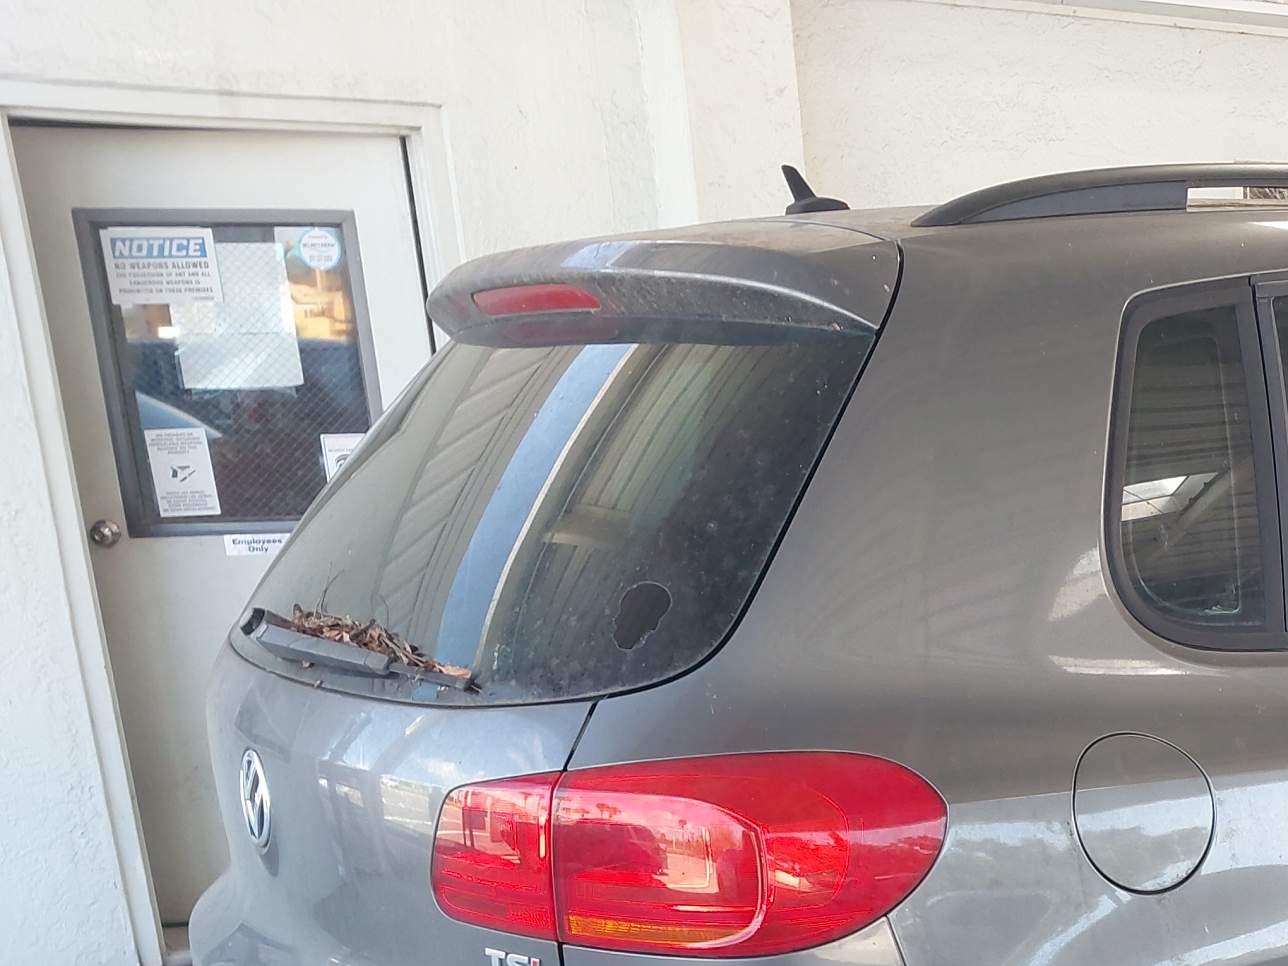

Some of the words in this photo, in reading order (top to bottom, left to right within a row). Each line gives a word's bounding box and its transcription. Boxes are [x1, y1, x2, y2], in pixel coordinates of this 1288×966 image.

[114, 238, 204, 257] NOTICE
[114, 262, 127, 270] NO
[129, 261, 169, 270] WEAPONS
[171, 260, 210, 269] ALLOWED
[231, 537, 283, 546] Employees
[247, 545, 269, 554] Only
